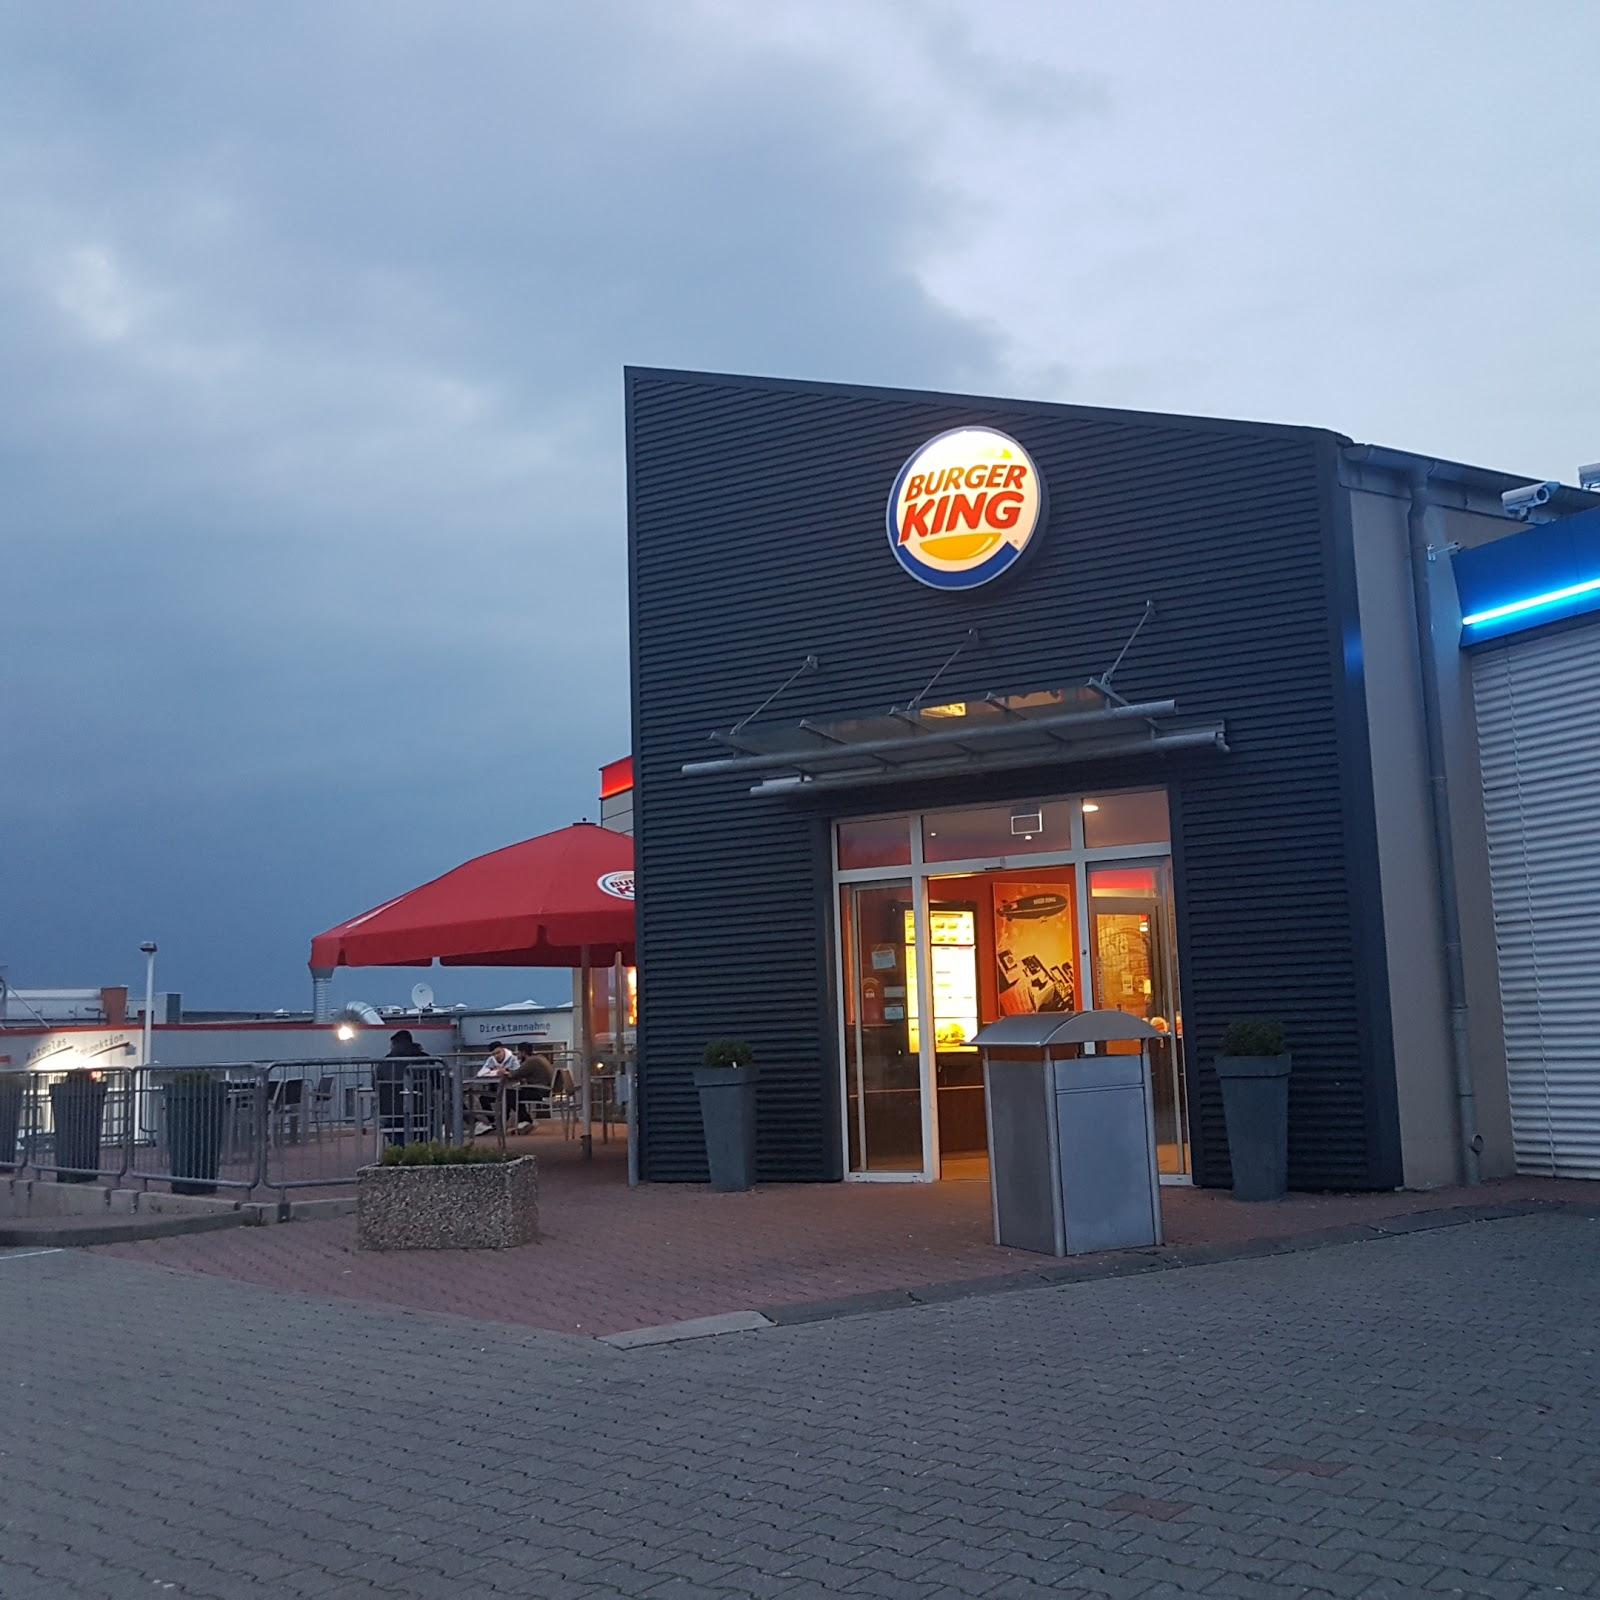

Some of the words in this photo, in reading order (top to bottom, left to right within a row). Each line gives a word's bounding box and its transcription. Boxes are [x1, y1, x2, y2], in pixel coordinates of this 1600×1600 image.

[904, 464, 1027, 502] BURGER
[900, 490, 1025, 543] KING
[479, 1021, 551, 1033] Direktannahme
